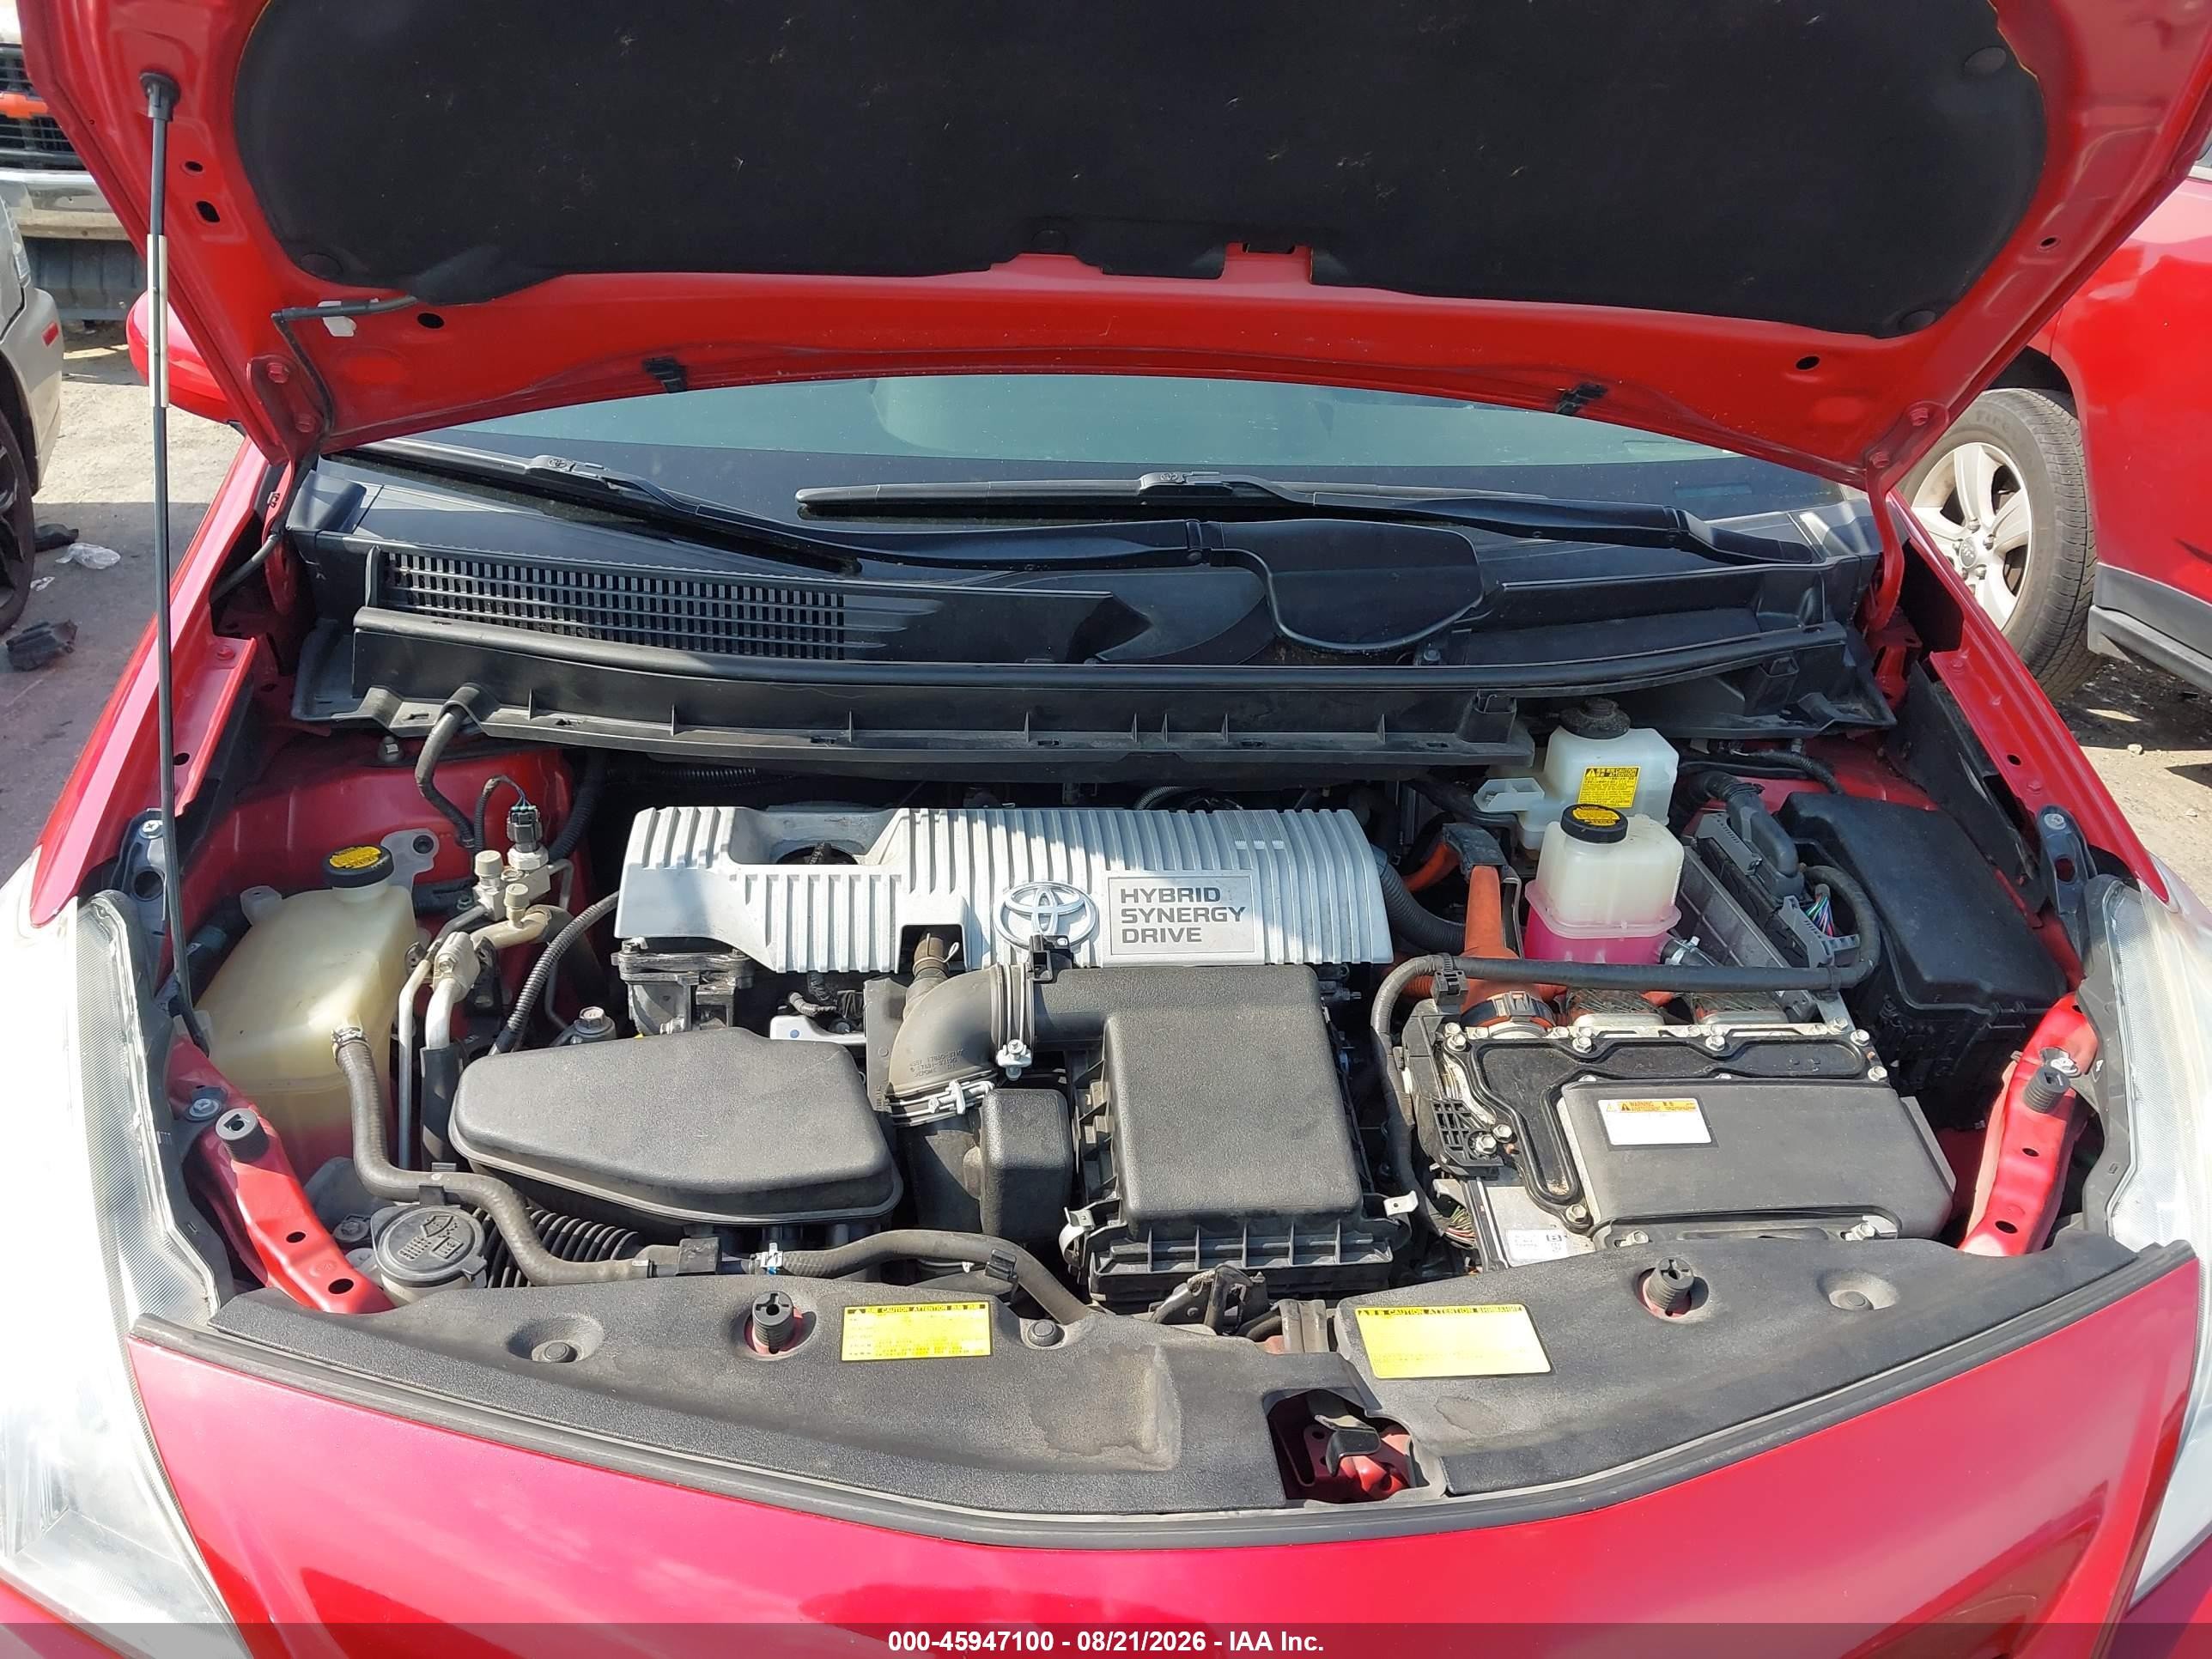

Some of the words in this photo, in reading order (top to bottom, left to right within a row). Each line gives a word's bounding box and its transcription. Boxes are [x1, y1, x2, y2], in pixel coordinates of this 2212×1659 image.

[1120, 887, 1221, 903] HYBRID
[1121, 906, 1247, 924] SYNERGY
[1121, 927, 1202, 944] DRIVE
